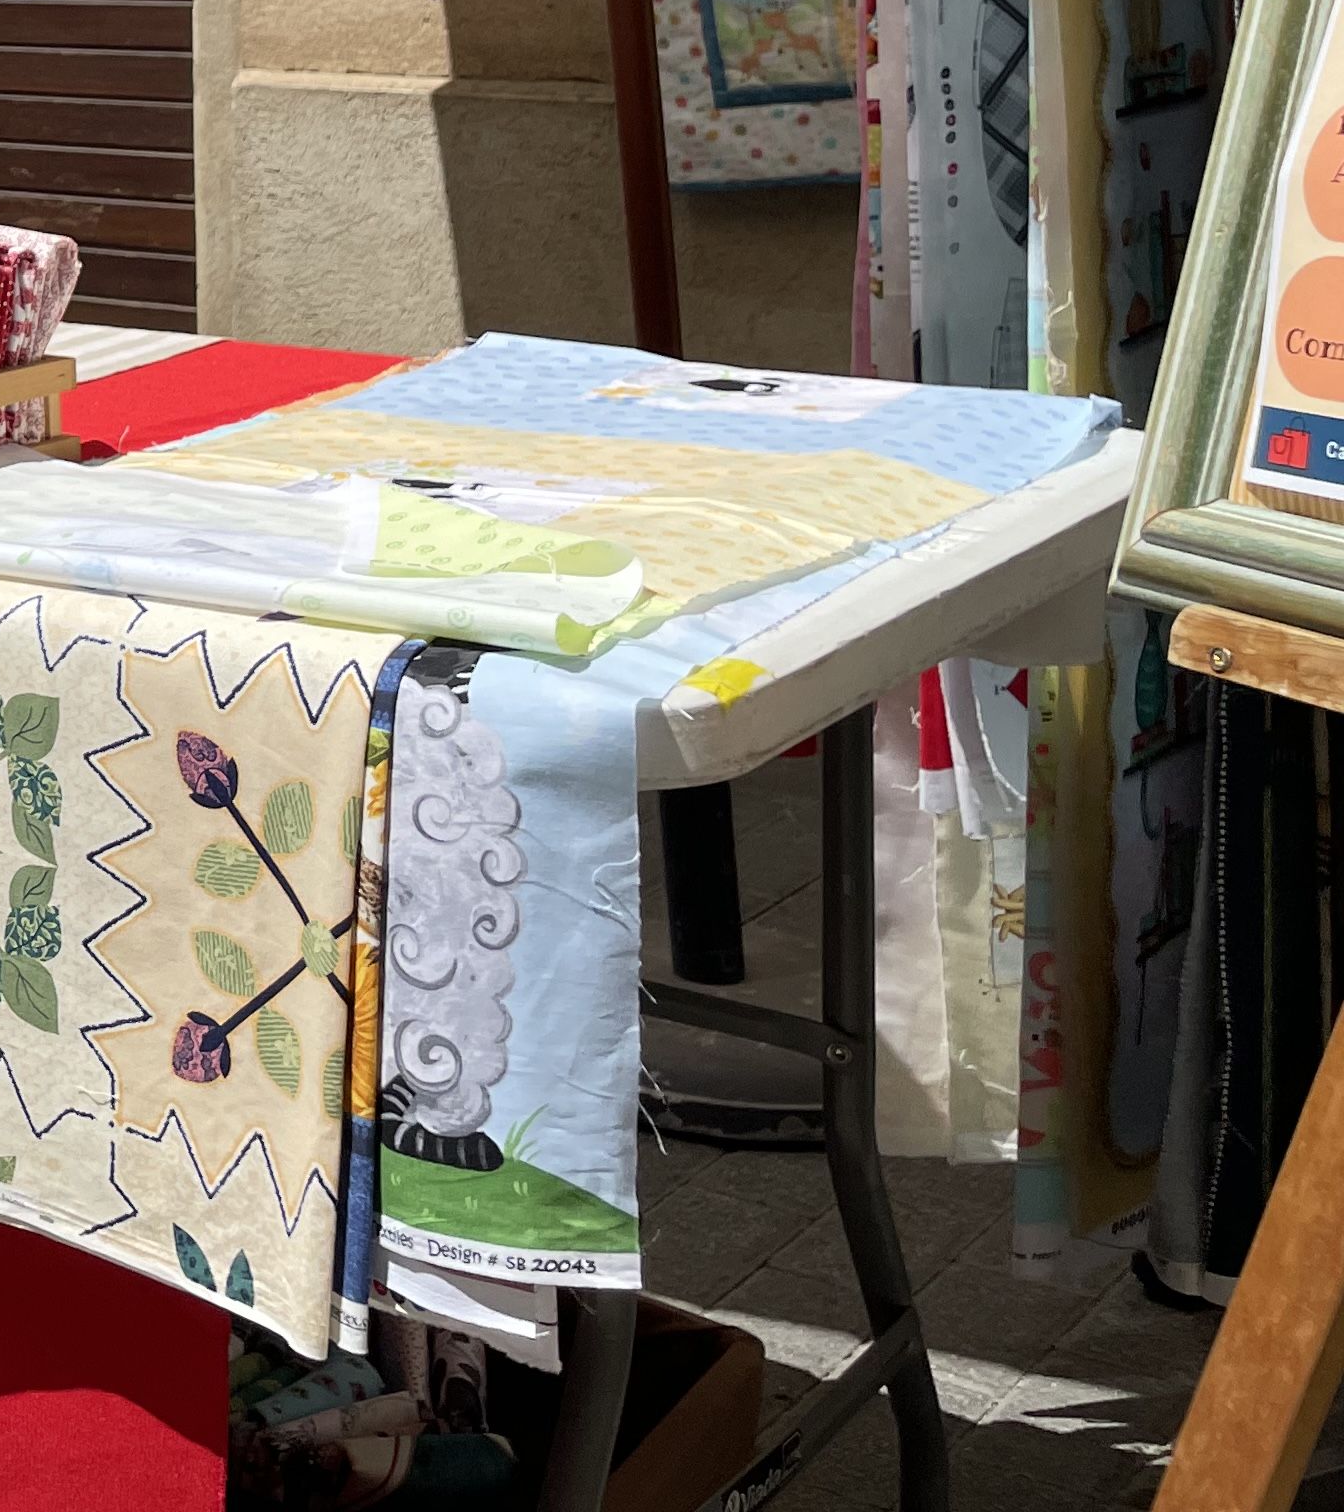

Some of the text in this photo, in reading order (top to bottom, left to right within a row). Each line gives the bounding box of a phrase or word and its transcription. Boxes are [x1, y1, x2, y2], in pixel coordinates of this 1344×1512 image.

[428, 1239, 482, 1265] Design
[506, 1255, 527, 1272] SB
[531, 1258, 597, 1274] 20043
